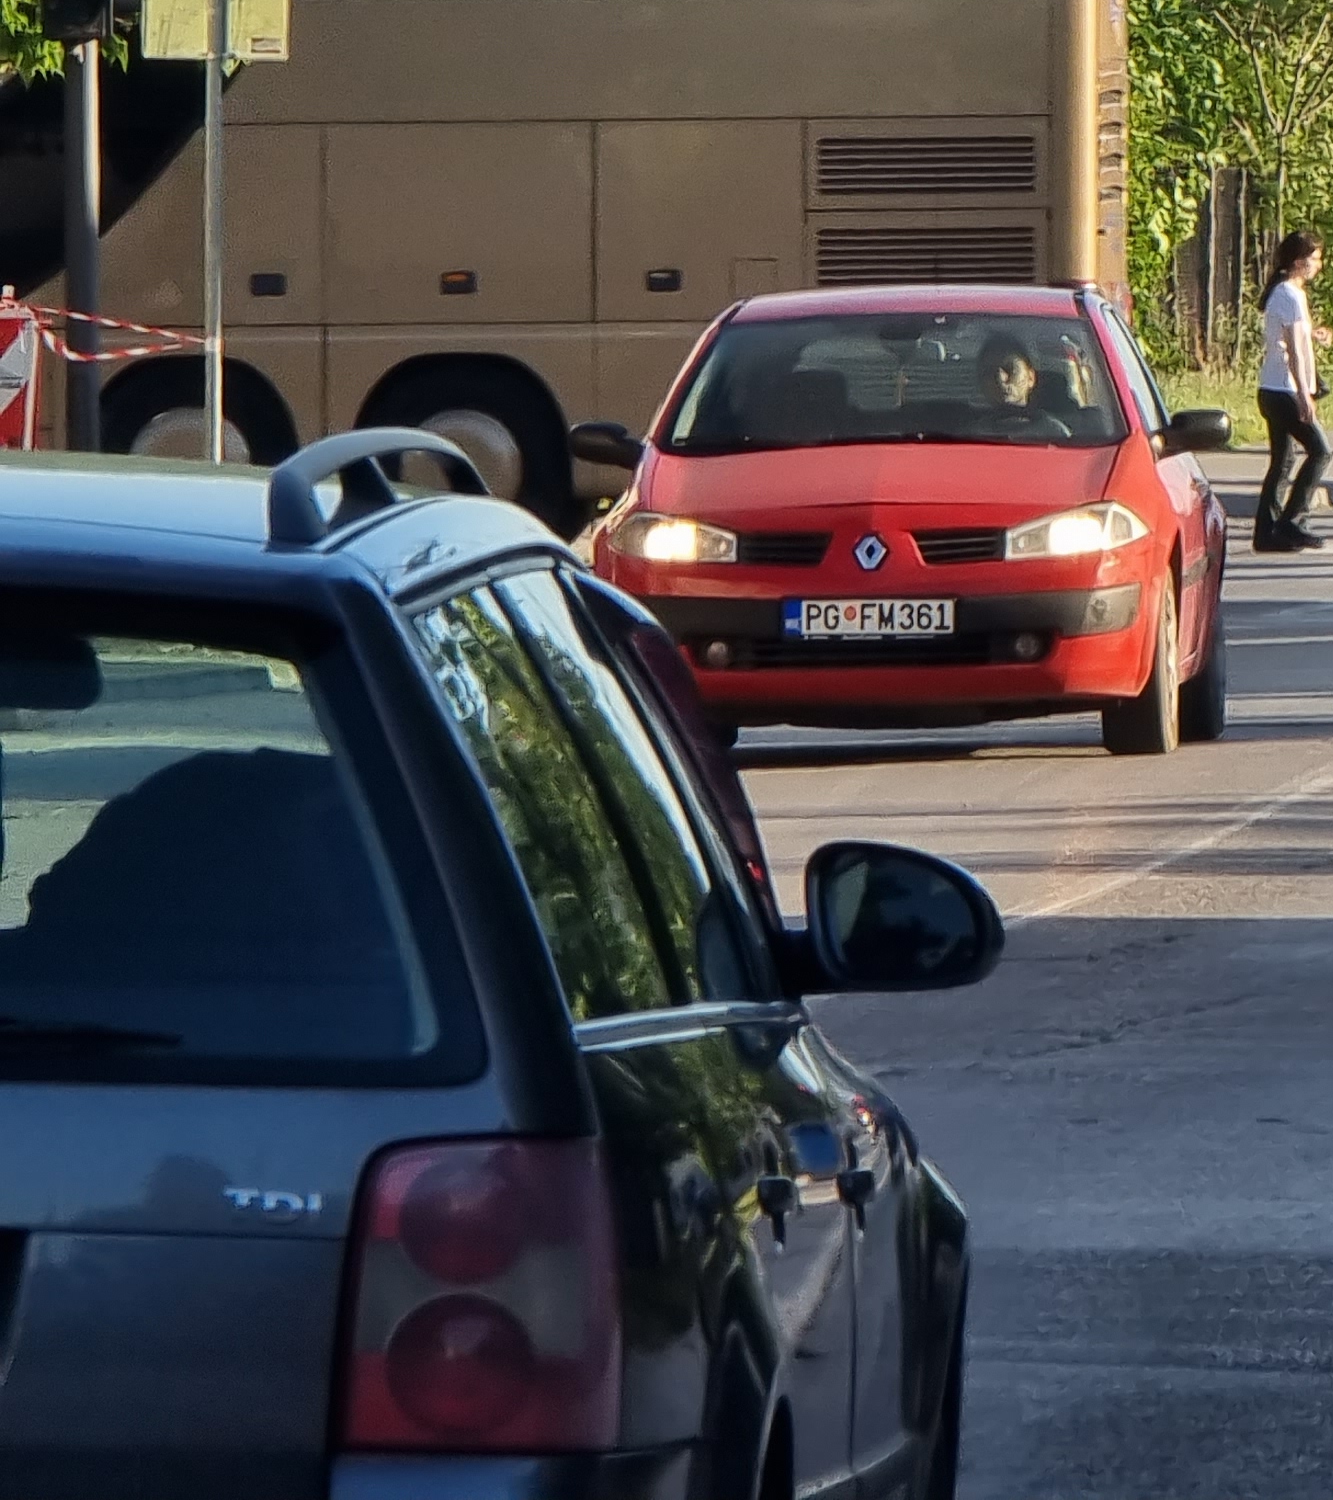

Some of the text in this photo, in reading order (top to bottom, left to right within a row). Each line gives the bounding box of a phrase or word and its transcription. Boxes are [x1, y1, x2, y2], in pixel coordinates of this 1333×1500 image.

[806, 603, 951, 631] PG FM361
[223, 1187, 323, 1221] TDI
